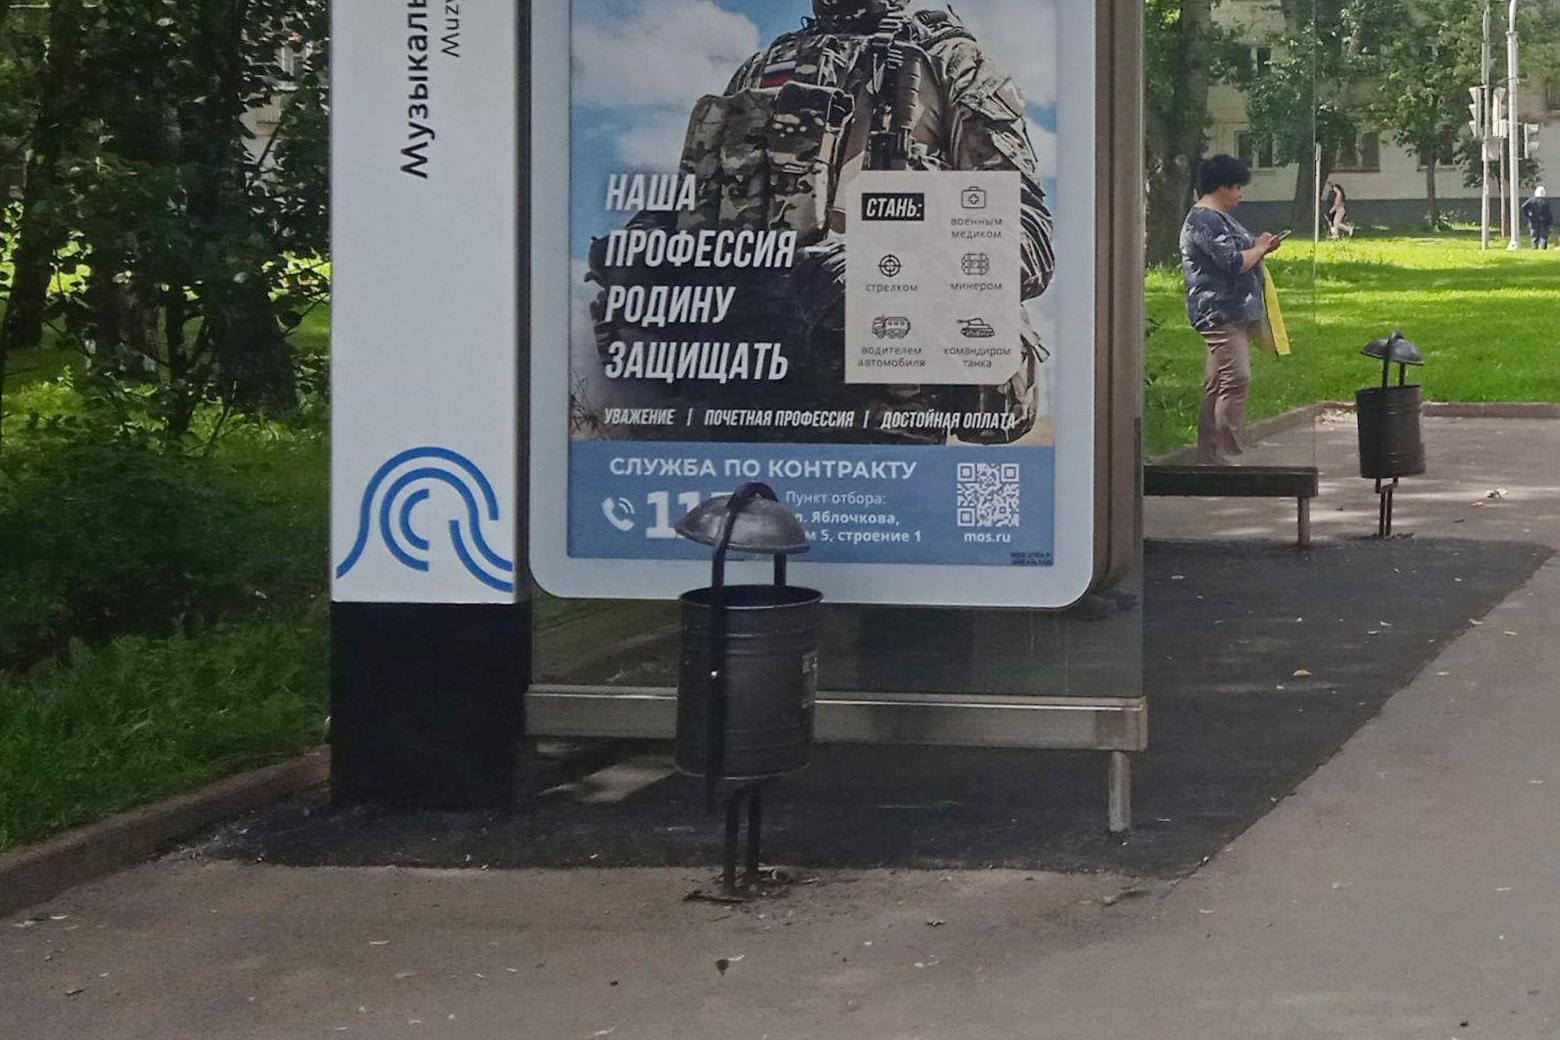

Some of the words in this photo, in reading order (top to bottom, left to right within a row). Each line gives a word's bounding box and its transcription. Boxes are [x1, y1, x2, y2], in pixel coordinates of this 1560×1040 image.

[605, 173, 696, 211] НАША
[865, 197, 923, 218] СТАНЬ:
[950, 217, 1003, 226] военным
[951, 229, 1002, 239] медиком
[604, 229, 798, 268] ПРОФЕССИЯ
[865, 283, 918, 294] стрелком
[950, 282, 1003, 293] минером
[604, 285, 737, 328] РОДИНУ
[861, 346, 923, 357] водителем
[943, 346, 1012, 357] командиром
[604, 340, 789, 384] ЗАЩИЩАТЬ
[857, 358, 926, 368] автомобиля
[962, 359, 993, 369] танка
[603, 408, 677, 426] УВАЖЕНИЕ
[704, 409, 772, 428] ПОЧЕТНАЯ
[774, 410, 855, 428] ПРОФЕССИЯ
[880, 409, 961, 430] ДОСТОЙНАЯ
[962, 412, 1017, 430] ОПЛАТА
[609, 458, 717, 478] СЛУЖБА
[724, 460, 759, 477] ПО
[768, 460, 917, 480] КОНТРАКТУ
[785, 490, 827, 506] Пункт
[831, 491, 888, 509] отбора:
[811, 511, 901, 527] Яблочкова,
[820, 529, 833, 543] 5,
[837, 532, 911, 545] строение
[914, 530, 922, 543] 1
[964, 532, 1011, 543] mos.ru
